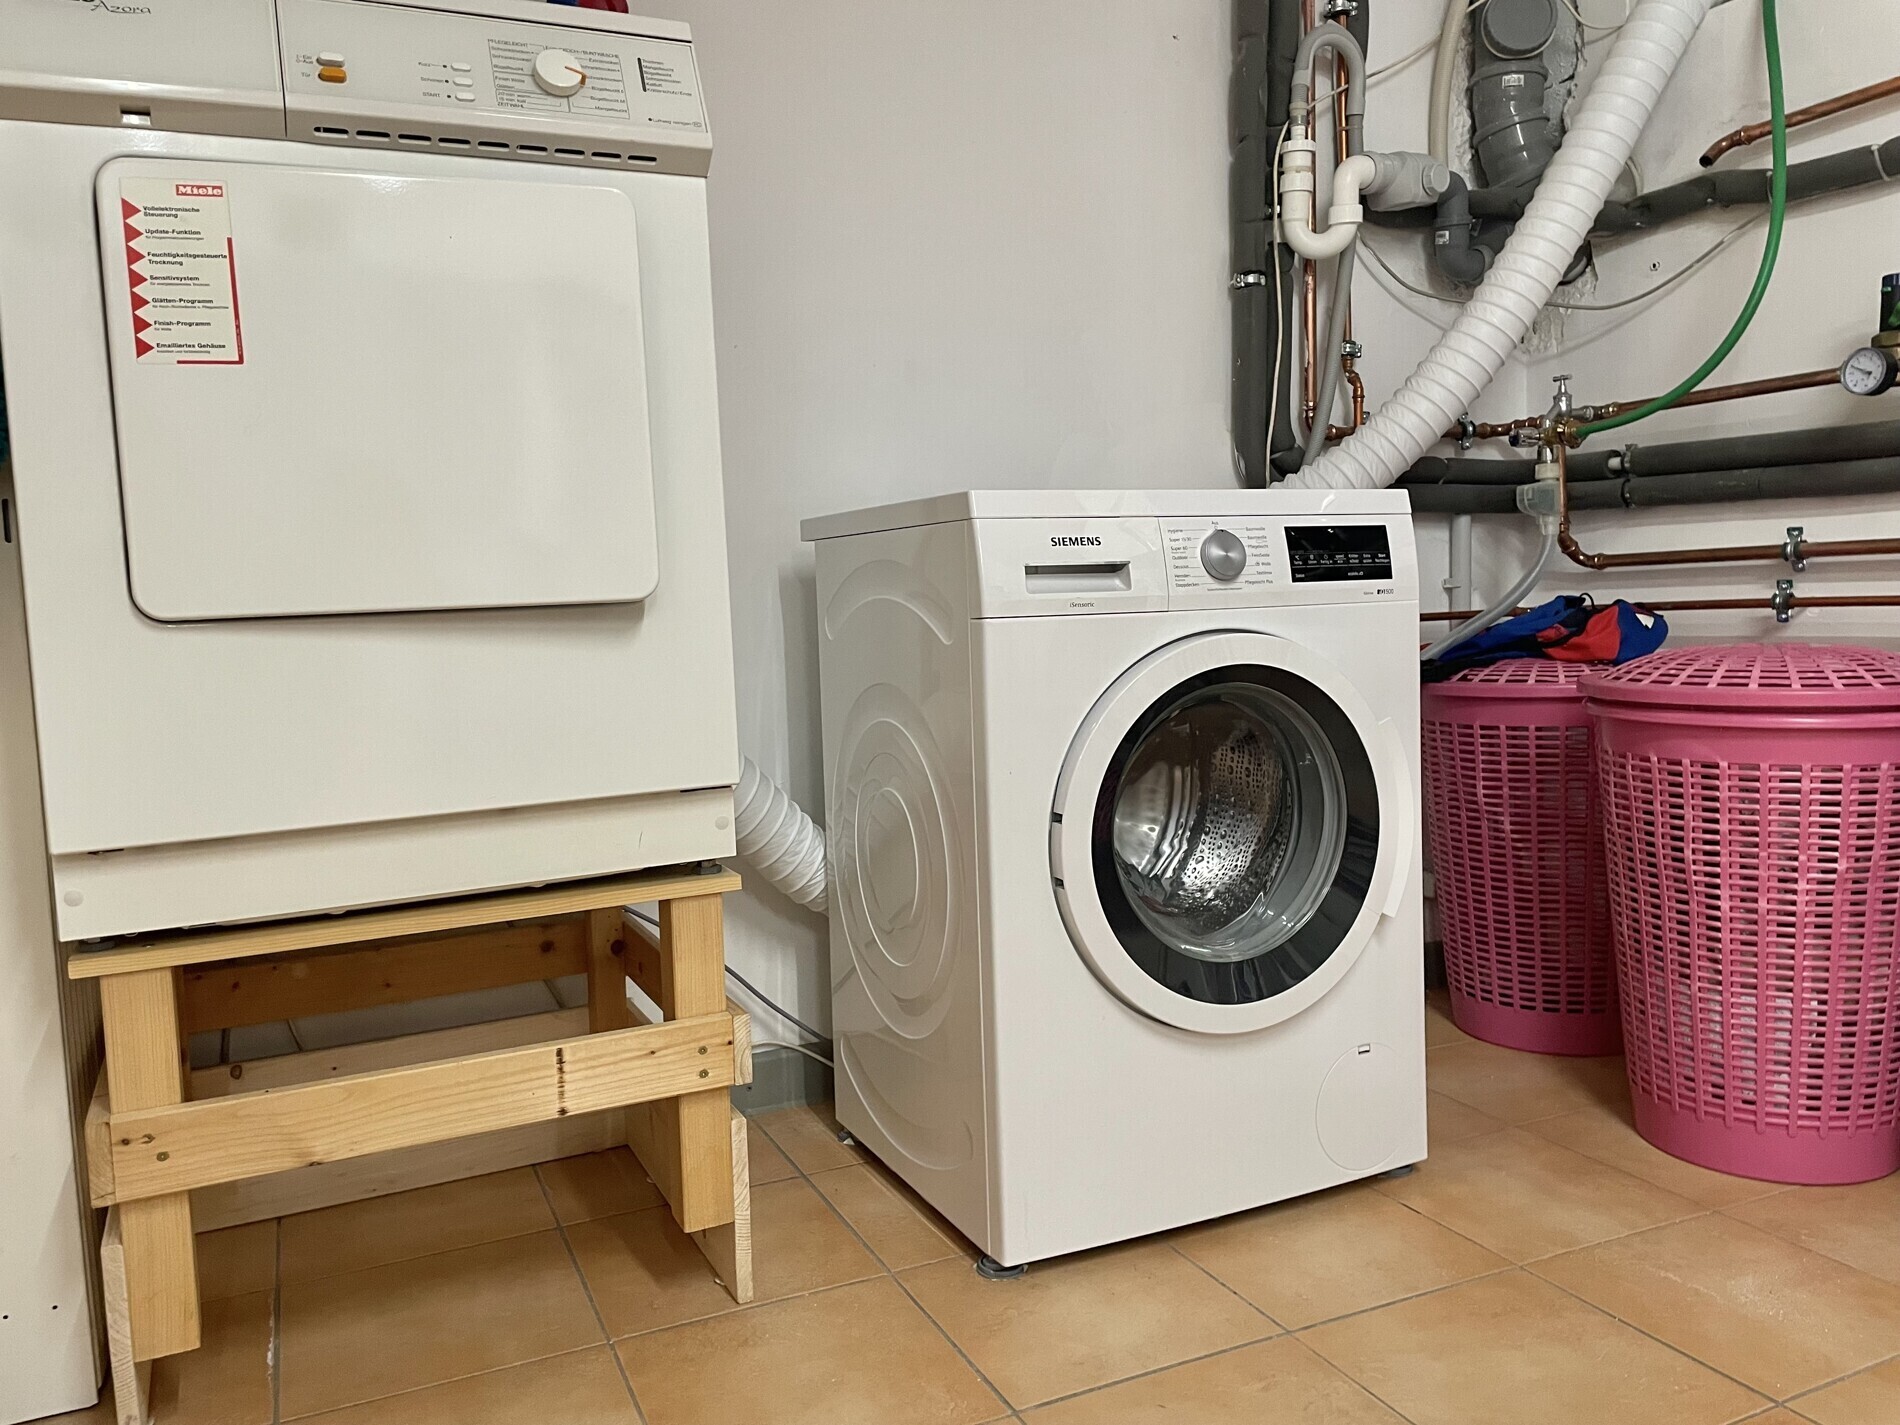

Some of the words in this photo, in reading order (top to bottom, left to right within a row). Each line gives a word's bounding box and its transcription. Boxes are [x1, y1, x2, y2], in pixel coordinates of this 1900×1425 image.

[177, 185, 222, 196] Miele
[147, 251, 228, 259] Feuchtigkeitsgesteuerte
[1050, 536, 1102, 547] SIEMENS
